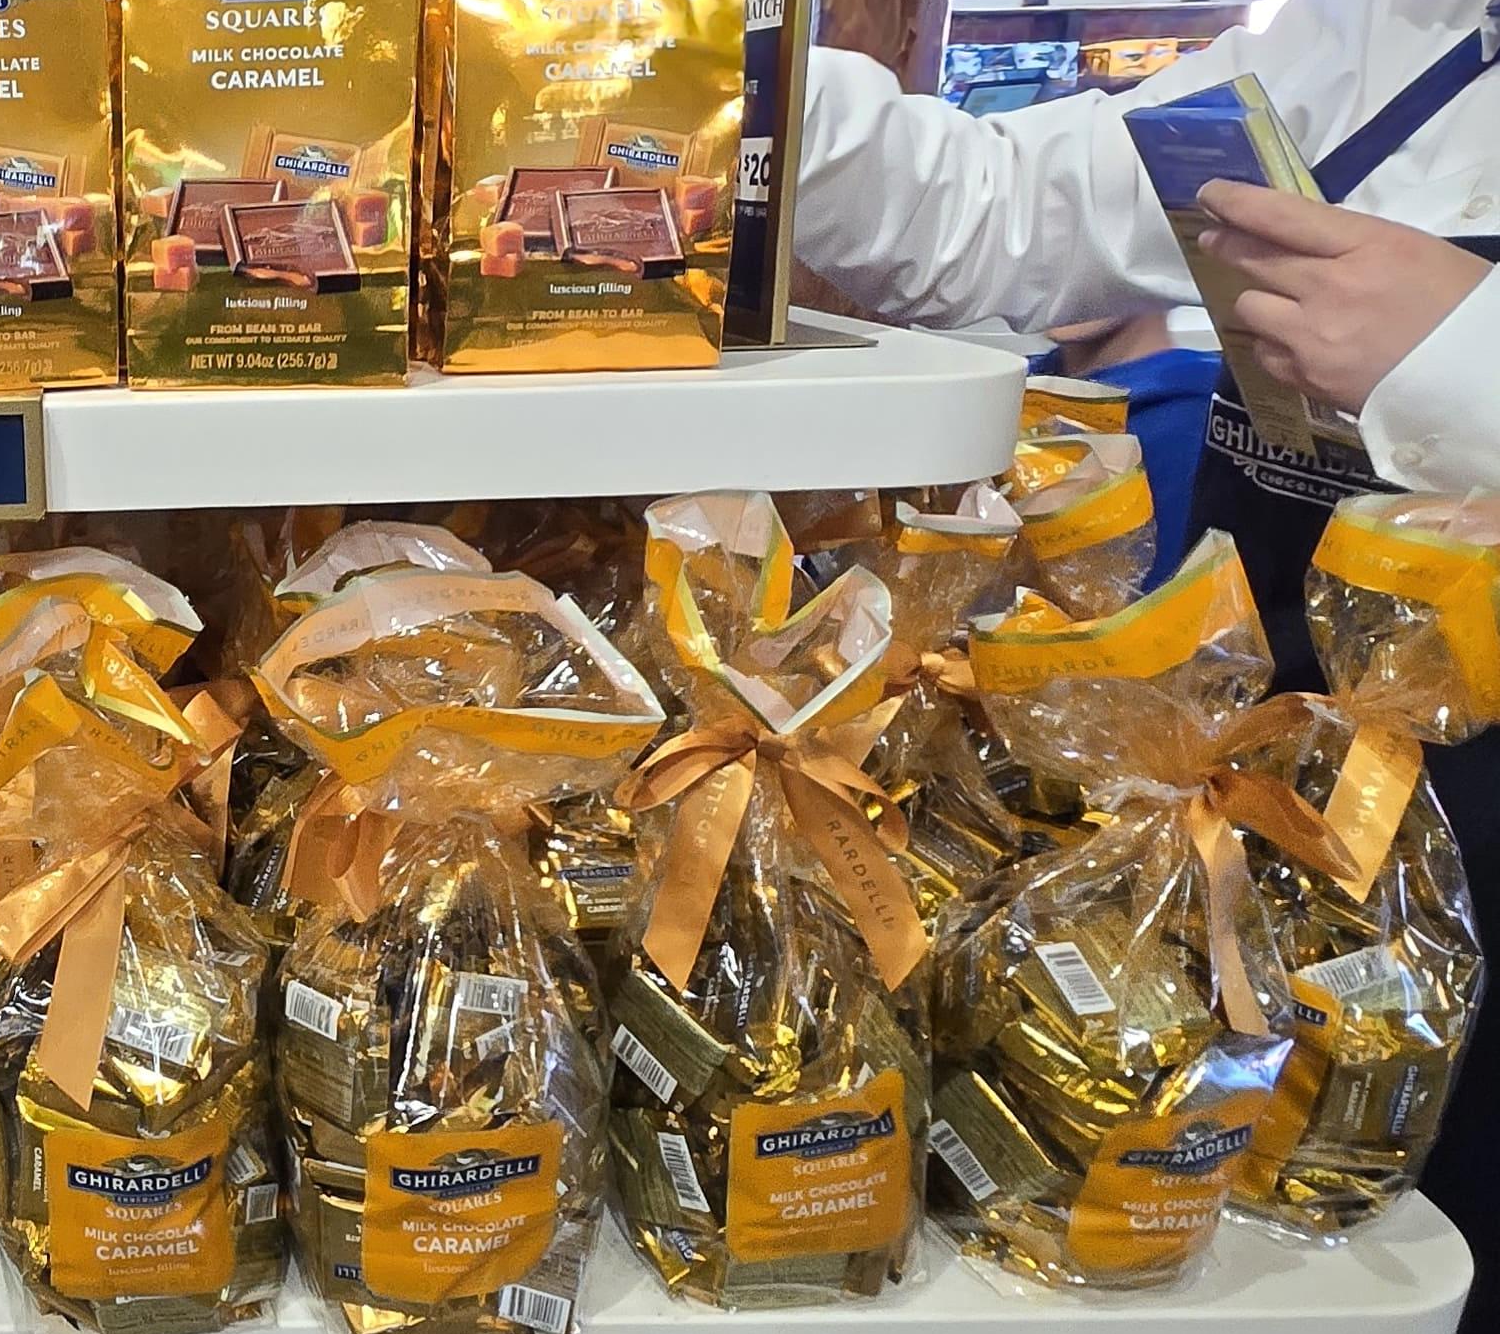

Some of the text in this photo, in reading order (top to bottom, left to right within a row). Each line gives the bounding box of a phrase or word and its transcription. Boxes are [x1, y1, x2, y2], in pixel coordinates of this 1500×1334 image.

[191, 45, 344, 63] MILK CHOCOLATE
[526, 42, 564, 54] MILK
[211, 68, 324, 89] CARAMEL
[610, 145, 678, 166] GHIRARDELLI
[277, 157, 348, 176] GHIRARDELLI
[550, 283, 632, 294] luscious filling
[225, 296, 307, 309] luscious filling
[532, 308, 644, 321] FROM BEAN TO BAR
[14, 332, 36, 341] BAR
[210, 323, 321, 334] FROM BEAN TO BAR
[190, 352, 327, 370] NET WT 9.04oz (256.7g)
[762, 1115, 893, 1152] GHIRARDELLI
[398, 1160, 534, 1188] GHIRARDELLI
[793, 1153, 868, 1177] SQUARES
[770, 1171, 888, 1204] MILK CHOCOLATE
[781, 1191, 879, 1220] CARAMEL
[84, 1220, 204, 1243] MILK CHOCOLA
[403, 1220, 437, 1232] MILK
[96, 1240, 199, 1261] CARAMEL
